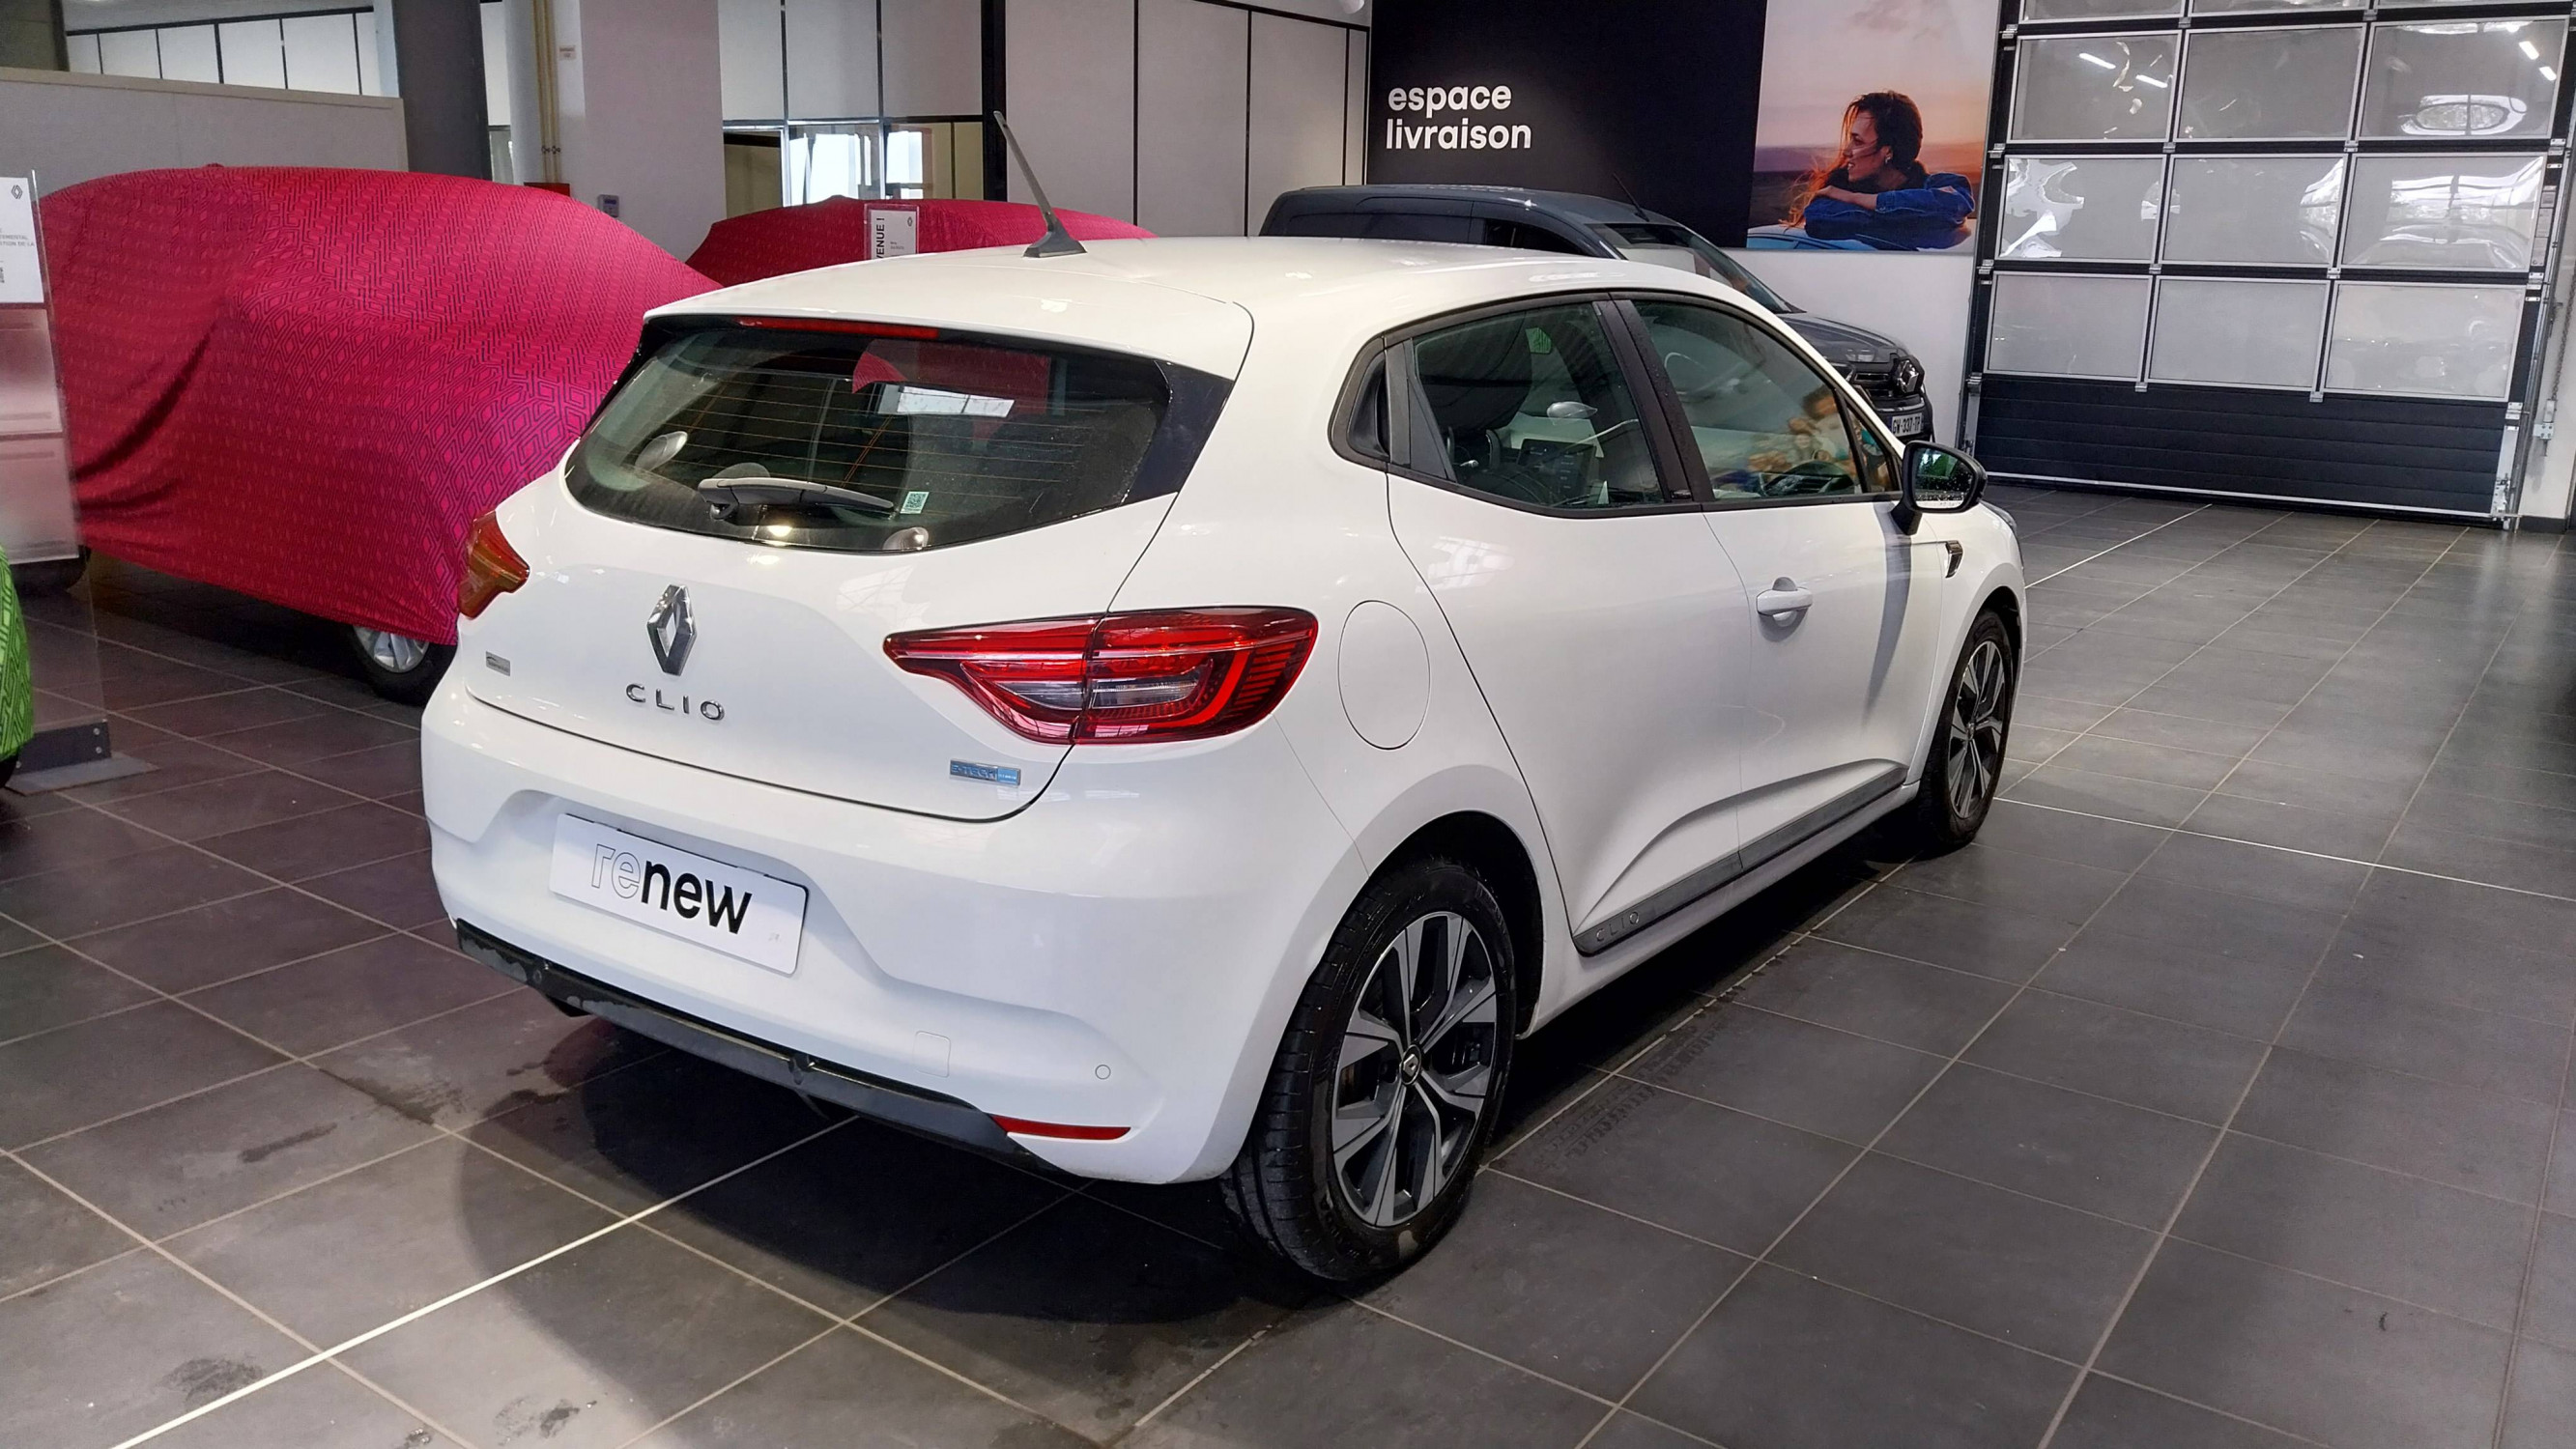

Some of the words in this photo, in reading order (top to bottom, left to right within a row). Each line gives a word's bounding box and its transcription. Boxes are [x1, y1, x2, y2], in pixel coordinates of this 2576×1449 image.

[1388, 85, 1511, 118] espace
[1387, 118, 1531, 149] livraison
[626, 683, 725, 721] CLIO
[591, 843, 753, 934] renew
[1596, 911, 1640, 942] CLIO
